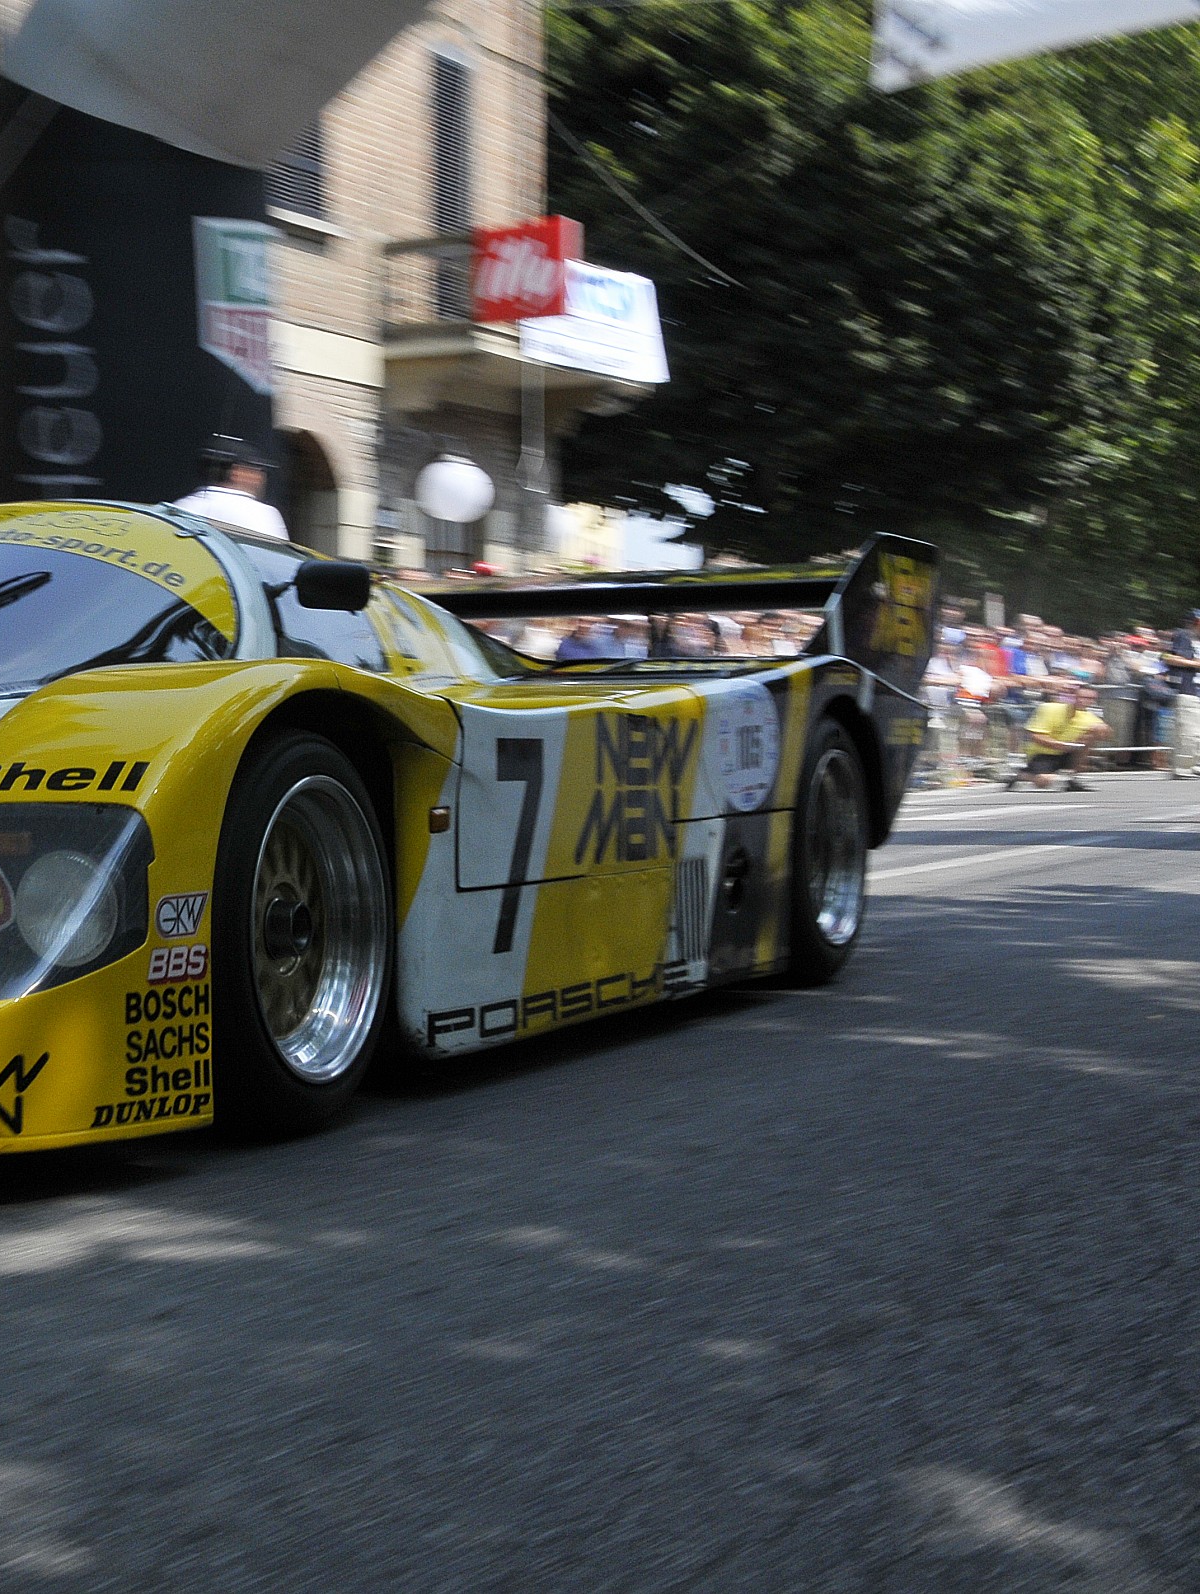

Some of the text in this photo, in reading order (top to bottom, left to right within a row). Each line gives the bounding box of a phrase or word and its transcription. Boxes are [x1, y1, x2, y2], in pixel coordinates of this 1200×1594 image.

[493, 737, 544, 954] 7
[148, 944, 209, 986] BBS
[124, 983, 210, 1025] BOSCH
[125, 1021, 210, 1064] SACHS
[124, 1057, 211, 1098] Shell
[90, 1093, 211, 1130] DUNLOP
